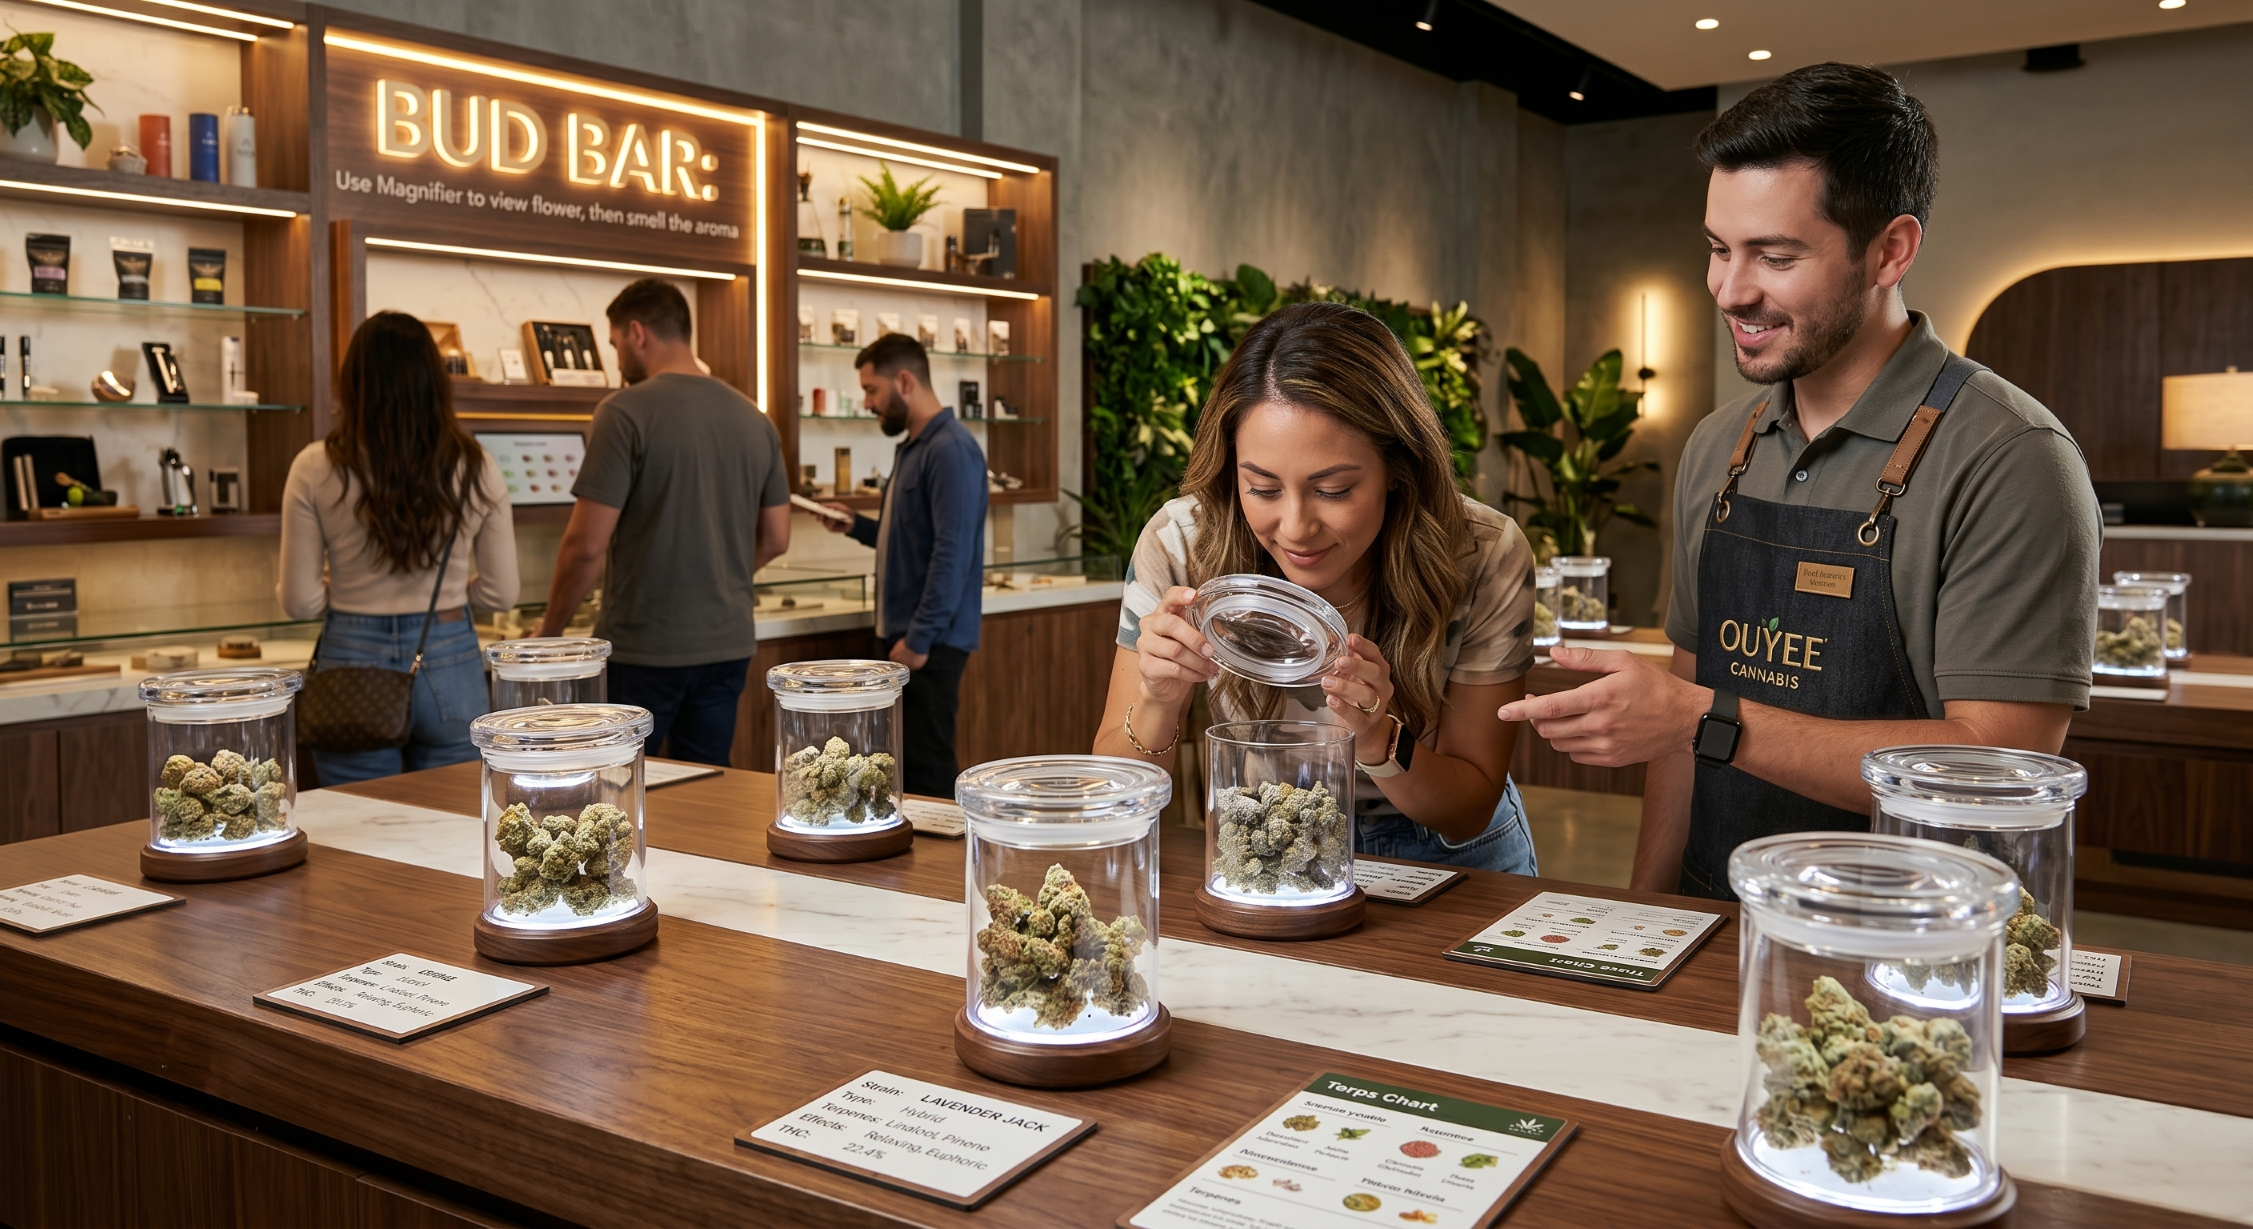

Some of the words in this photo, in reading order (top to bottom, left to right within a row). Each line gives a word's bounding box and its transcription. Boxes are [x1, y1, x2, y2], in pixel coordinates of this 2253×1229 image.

[376, 79, 549, 174] BUD
[567, 112, 719, 201] BAR:
[336, 170, 372, 193] Use
[377, 174, 463, 204] Magnifier
[467, 189, 486, 207] to
[489, 191, 528, 213] view
[532, 194, 586, 222] flower,
[589, 202, 624, 225] then
[626, 210, 666, 230] smell
[668, 213, 693, 234] the
[695, 220, 739, 239] aroma
[1730, 661, 1799, 690] CANNABIS
[841, 1090, 876, 1105] Type:
[900, 1106, 947, 1124] Hybrid
[862, 1081, 904, 1096] Strain:
[920, 1094, 1003, 1121] LAVENDER
[1002, 1115, 1050, 1133] JACK
[1327, 1080, 1379, 1098] Terps
[1382, 1093, 1439, 1112] Chart
[778, 1124, 811, 1138] THC:
[842, 1142, 887, 1160] 22.4%
[799, 1113, 848, 1131] Effects:
[925, 1147, 989, 1171] Euphoric
[822, 1102, 883, 1123] Terpenes:
[941, 1134, 991, 1152] Pinene
